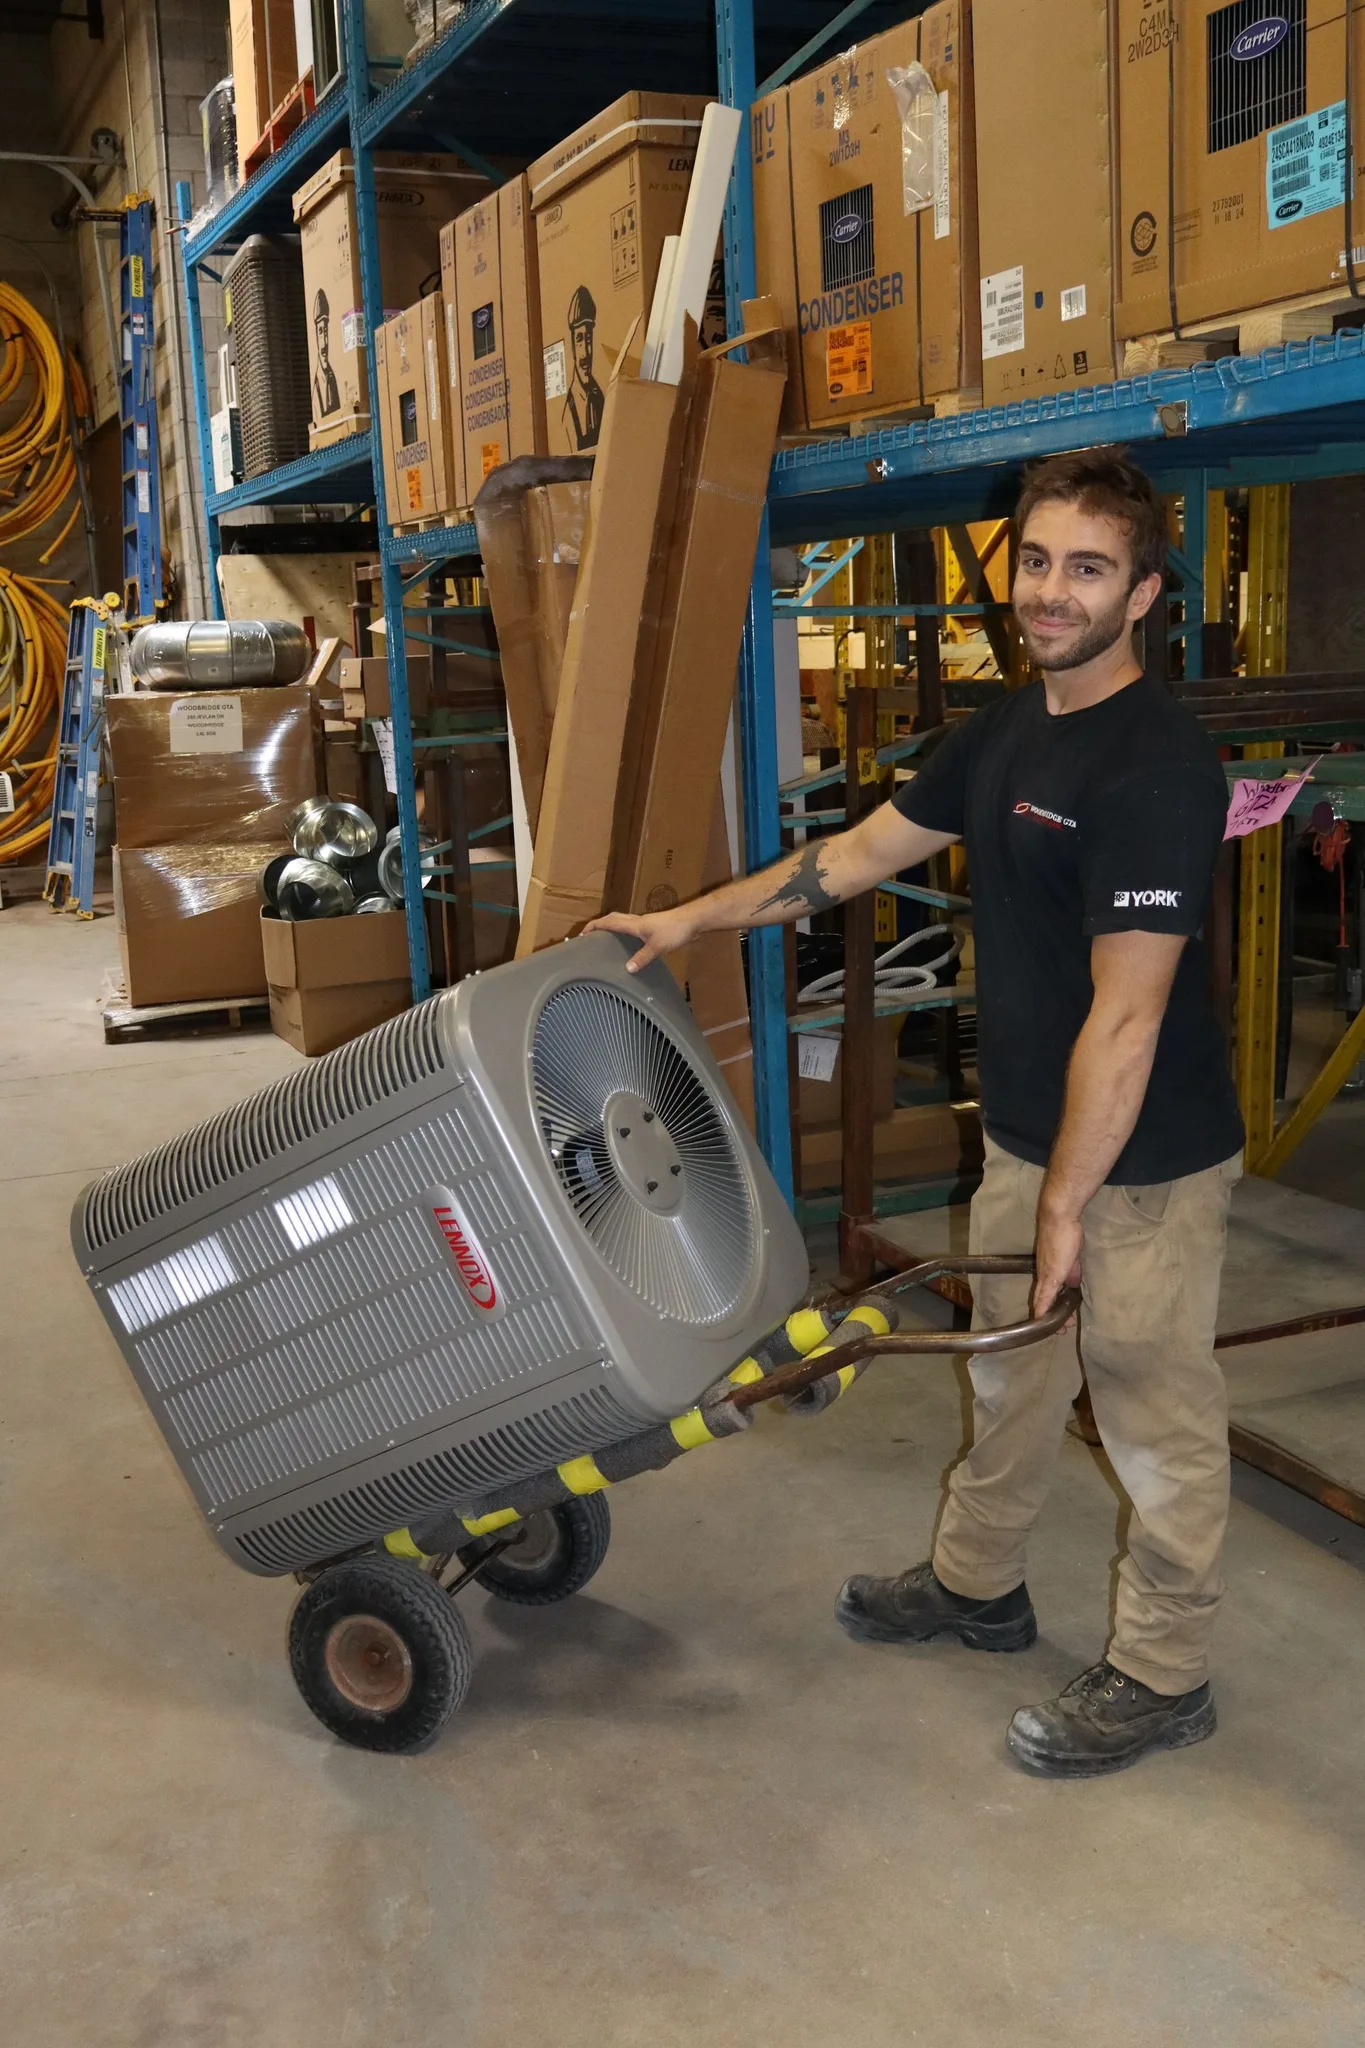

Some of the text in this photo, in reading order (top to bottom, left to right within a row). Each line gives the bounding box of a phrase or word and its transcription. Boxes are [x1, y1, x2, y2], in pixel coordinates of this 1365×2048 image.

[1139, 9, 1166, 38] C4M
[1237, 22, 1281, 54] Carrier
[374, 191, 415, 205] ENNOX
[1278, 202, 1300, 216] Carrier
[834, 219, 859, 238] Carrier
[132, 256, 141, 297] FEATHERLITE
[799, 271, 904, 336] CONDENSER
[469, 357, 505, 387] CONDENSER
[465, 378, 511, 411] CONDENSATEUR
[467, 402, 511, 432] CONDENSADOR
[396, 440, 428, 471] CONDENSER
[95, 629, 104, 668] FEATHERLITE
[177, 704, 221, 712] WOODBRIDGE
[1062, 818, 1077, 829] GTA
[1131, 889, 1179, 908] YORK
[432, 1207, 489, 1289] LENNOX
